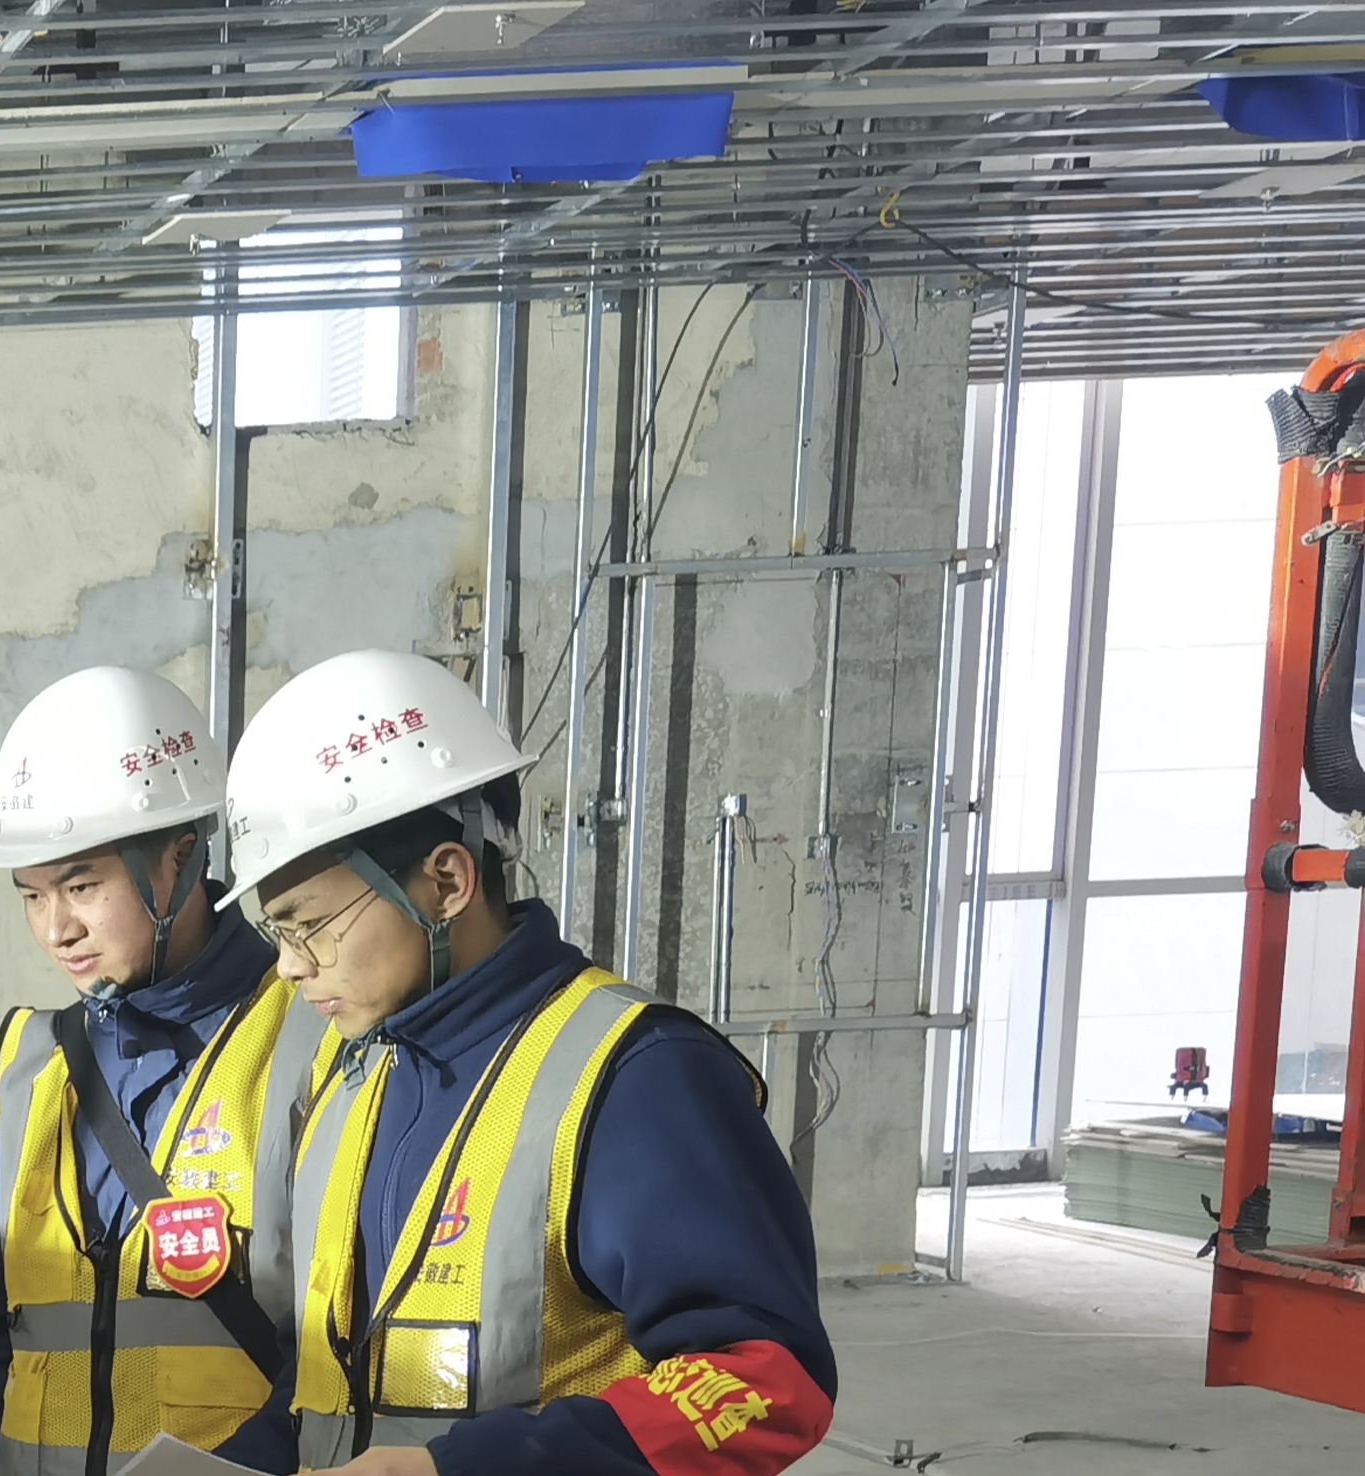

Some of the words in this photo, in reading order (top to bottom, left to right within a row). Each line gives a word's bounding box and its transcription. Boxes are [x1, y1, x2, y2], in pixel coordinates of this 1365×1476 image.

[119, 730, 198, 778] 安全检查
[315, 707, 429, 774] 安全检查
[158, 1226, 221, 1260] 安全员
